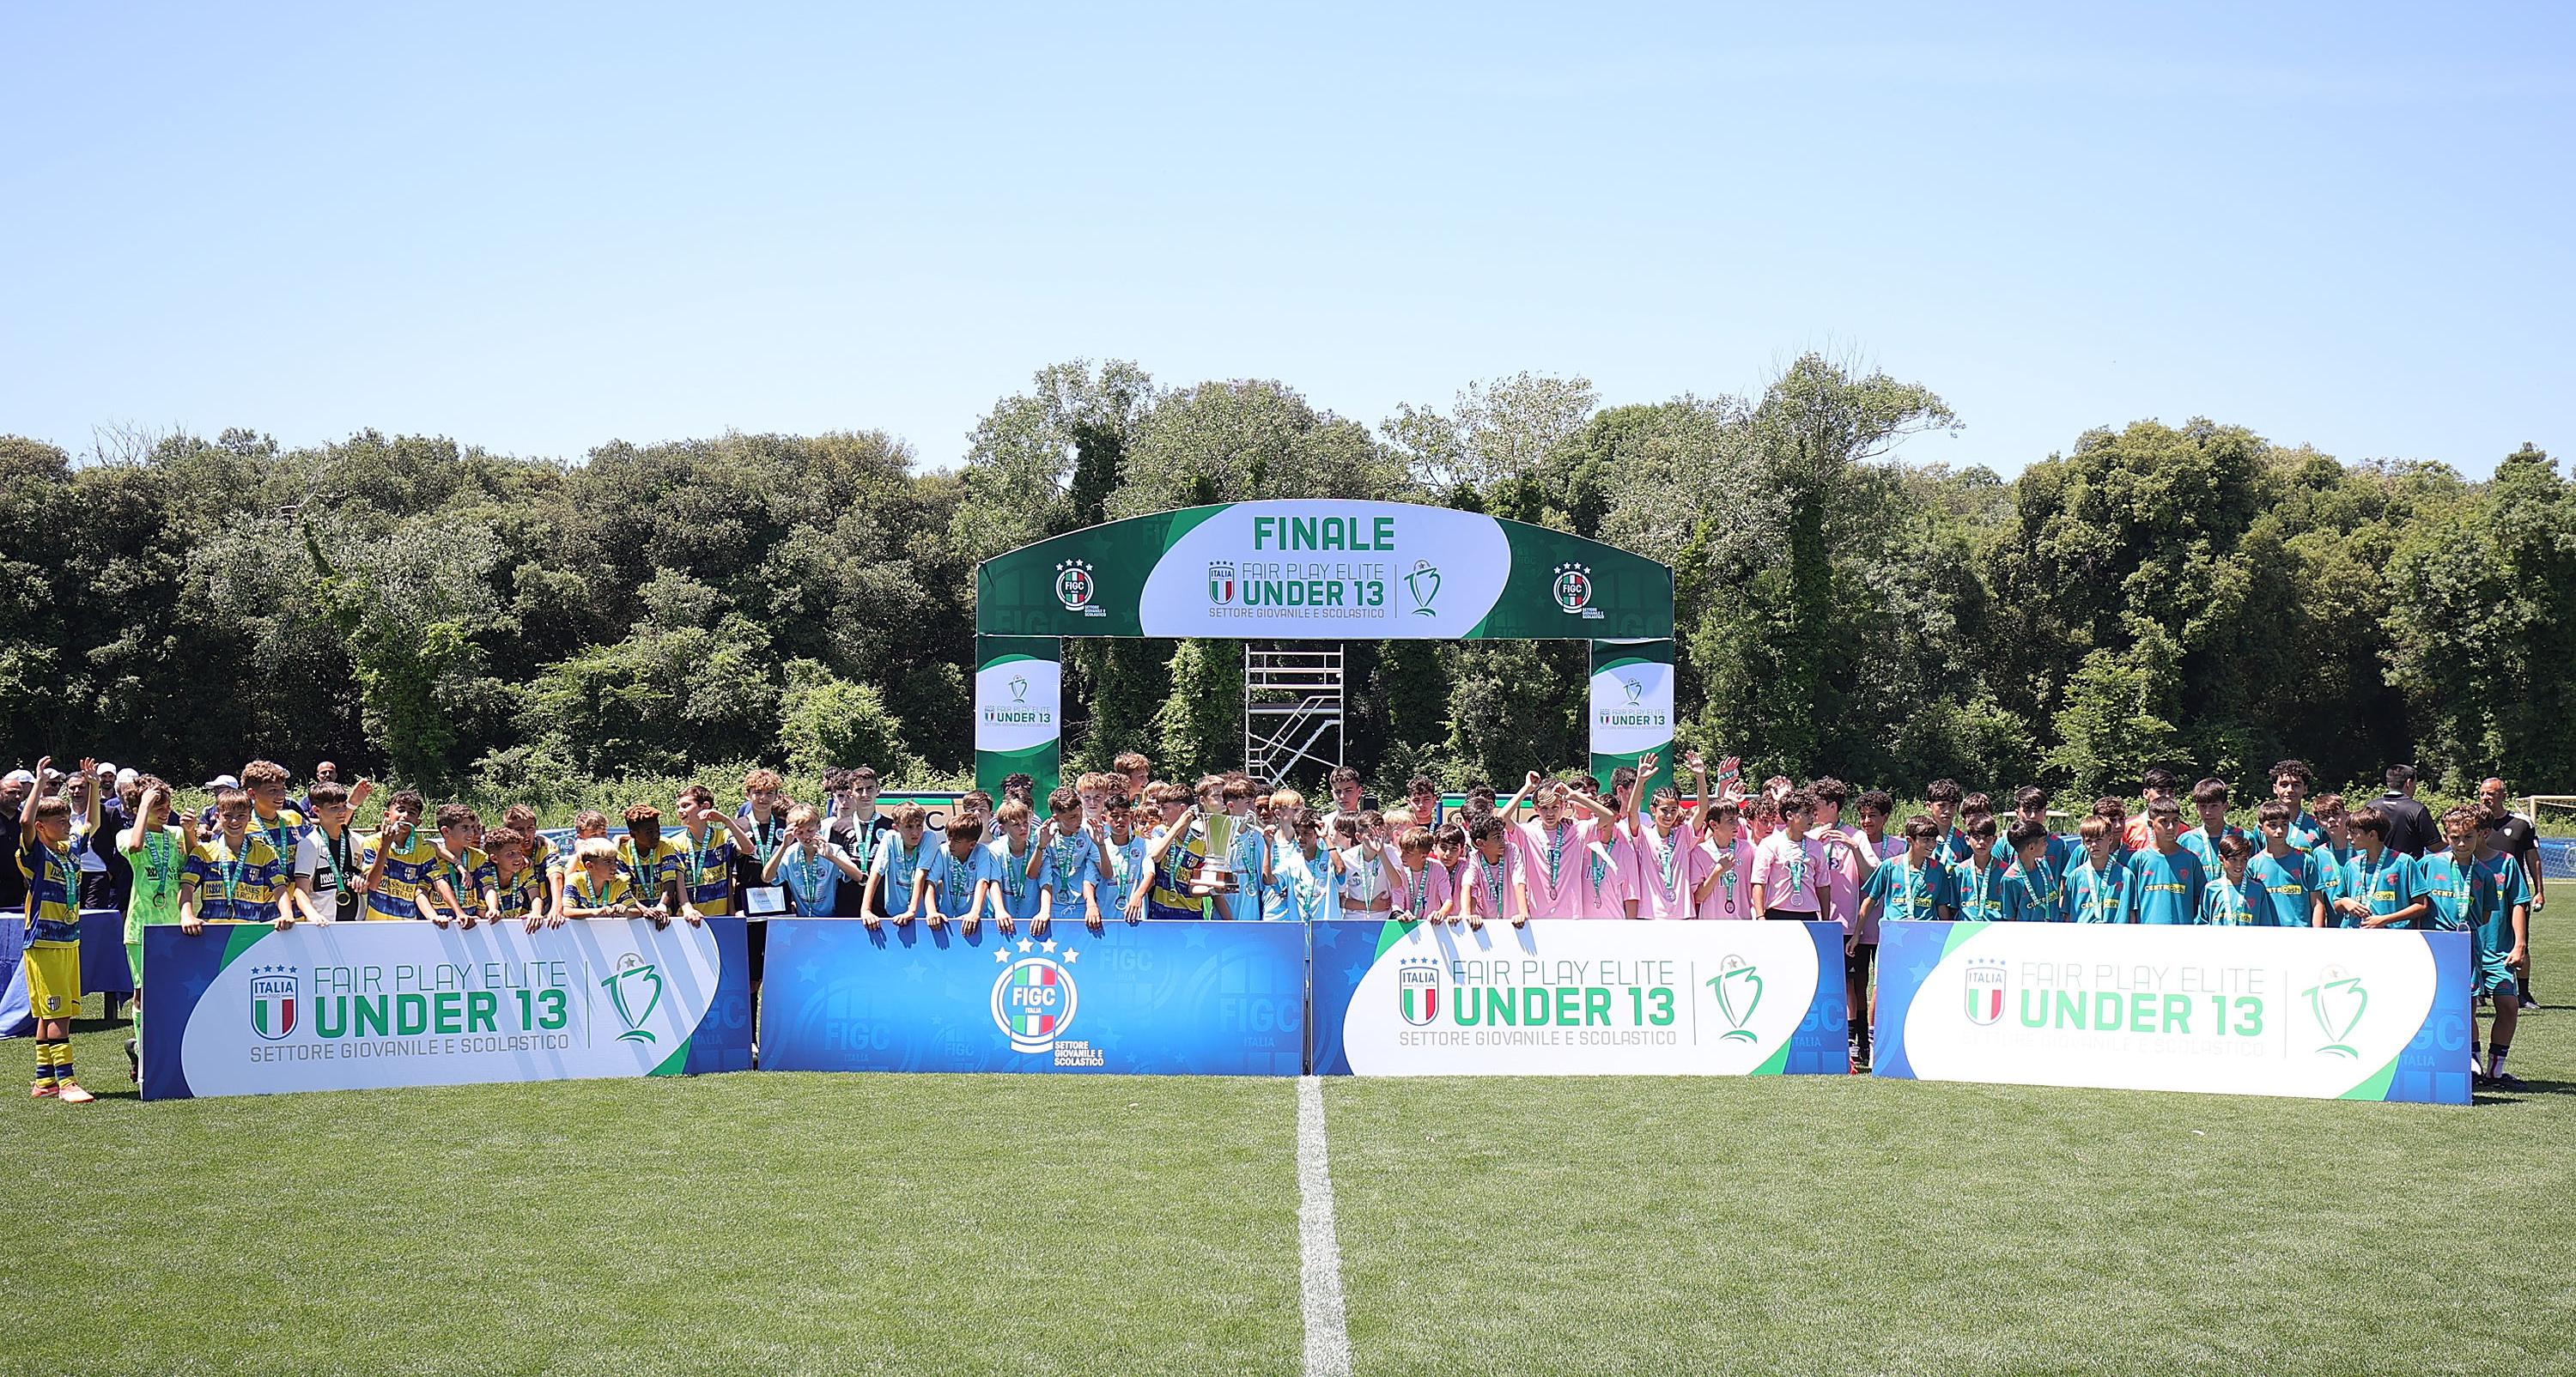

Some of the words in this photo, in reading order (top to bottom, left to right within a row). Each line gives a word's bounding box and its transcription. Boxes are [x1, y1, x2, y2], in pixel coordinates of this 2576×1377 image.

[1254, 517, 1394, 550] FINALE
[1211, 570, 1232, 579] ITALIA
[1242, 562, 1279, 580] FAIR
[1286, 563, 1330, 580] PLAY
[1336, 564, 1383, 580] ELITE
[1065, 581, 1084, 591] FIGC
[1243, 580, 1344, 606] UNDER
[1355, 581, 1384, 606] 13
[1563, 584, 1583, 593] FIGC
[1209, 607, 1254, 618] SETTORE
[1256, 608, 1310, 618] GIOVANILE
[1314, 609, 1319, 618] E
[1322, 609, 1384, 619] SCOLASTICO
[997, 713, 1036, 723] UNDER
[1038, 713, 1051, 723] 13
[1612, 715, 1650, 725] UNDER
[1653, 716, 1666, 725] 13
[150, 846, 161, 865] FINALE
[236, 851, 247, 870] FINALE
[1419, 870, 1428, 888] FINALE
[1484, 866, 1493, 883] FINALE
[314, 966, 382, 994] FAIR
[397, 963, 472, 992] PLAY
[485, 961, 567, 988] ELITE
[1402, 972, 1435, 984] ITALIA
[1453, 961, 1510, 986] FAIR
[1522, 961, 1589, 986] PLAY
[1601, 961, 1674, 986] ELITE
[1969, 972, 2002, 984] ITALIA
[2021, 961, 2082, 987] FAIR
[2096, 964, 2169, 992] PLAY
[2182, 967, 2264, 994] ELITE
[254, 981, 294, 995] ITALIA
[1012, 987, 1056, 1006] FIGC
[315, 991, 497, 1039] UNDER
[516, 989, 568, 1031] 13
[1219, 998, 1300, 1032] FIGC
[1453, 987, 1612, 1026] UNDER
[1628, 987, 1675, 1026] 13
[2020, 989, 2192, 1034] UNDER
[2212, 995, 2264, 1037] 13
[824, 1022, 890, 1051] FIGC
[1054, 1040, 1089, 1049] SETTORE
[1244, 1037, 1276, 1048] ITALIA
[1400, 1031, 1470, 1046] SETTORE
[1476, 1031, 1559, 1046] GIOVANILE
[1566, 1031, 1574, 1046] E
[1579, 1031, 1676, 1046] SCOLASTICO
[251, 1043, 334, 1063] SETTORE
[343, 1039, 439, 1059] GIOVANILE
[445, 1038, 454, 1054] E
[461, 1034, 568, 1054] SCOLASTICO
[1054, 1049, 1096, 1058] GIOVANILE
[1097, 1049, 1103, 1058] E
[1054, 1057, 1103, 1066] SCOLASTICO
